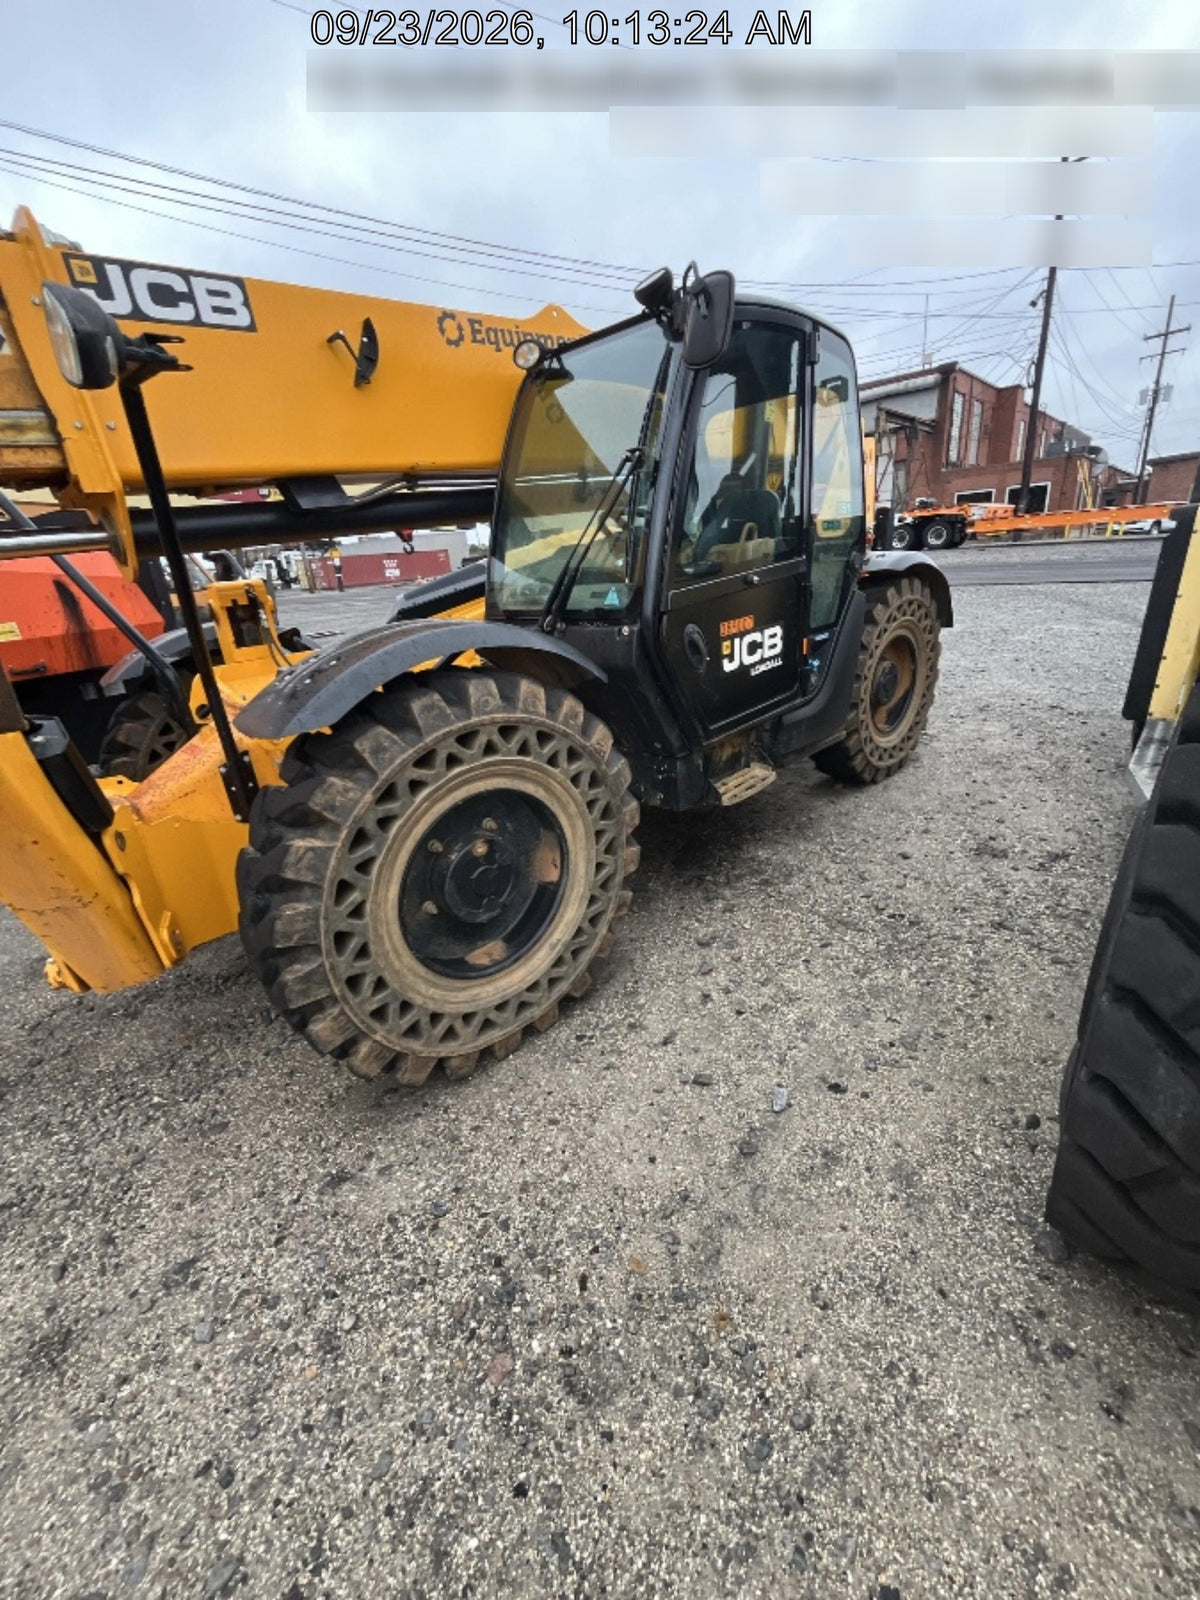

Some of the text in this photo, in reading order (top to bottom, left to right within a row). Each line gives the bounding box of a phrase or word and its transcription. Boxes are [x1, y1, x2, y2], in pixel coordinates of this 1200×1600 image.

[79, 263, 251, 327] JCB
[467, 317, 585, 352] Equim
[723, 625, 783, 672] JCB
